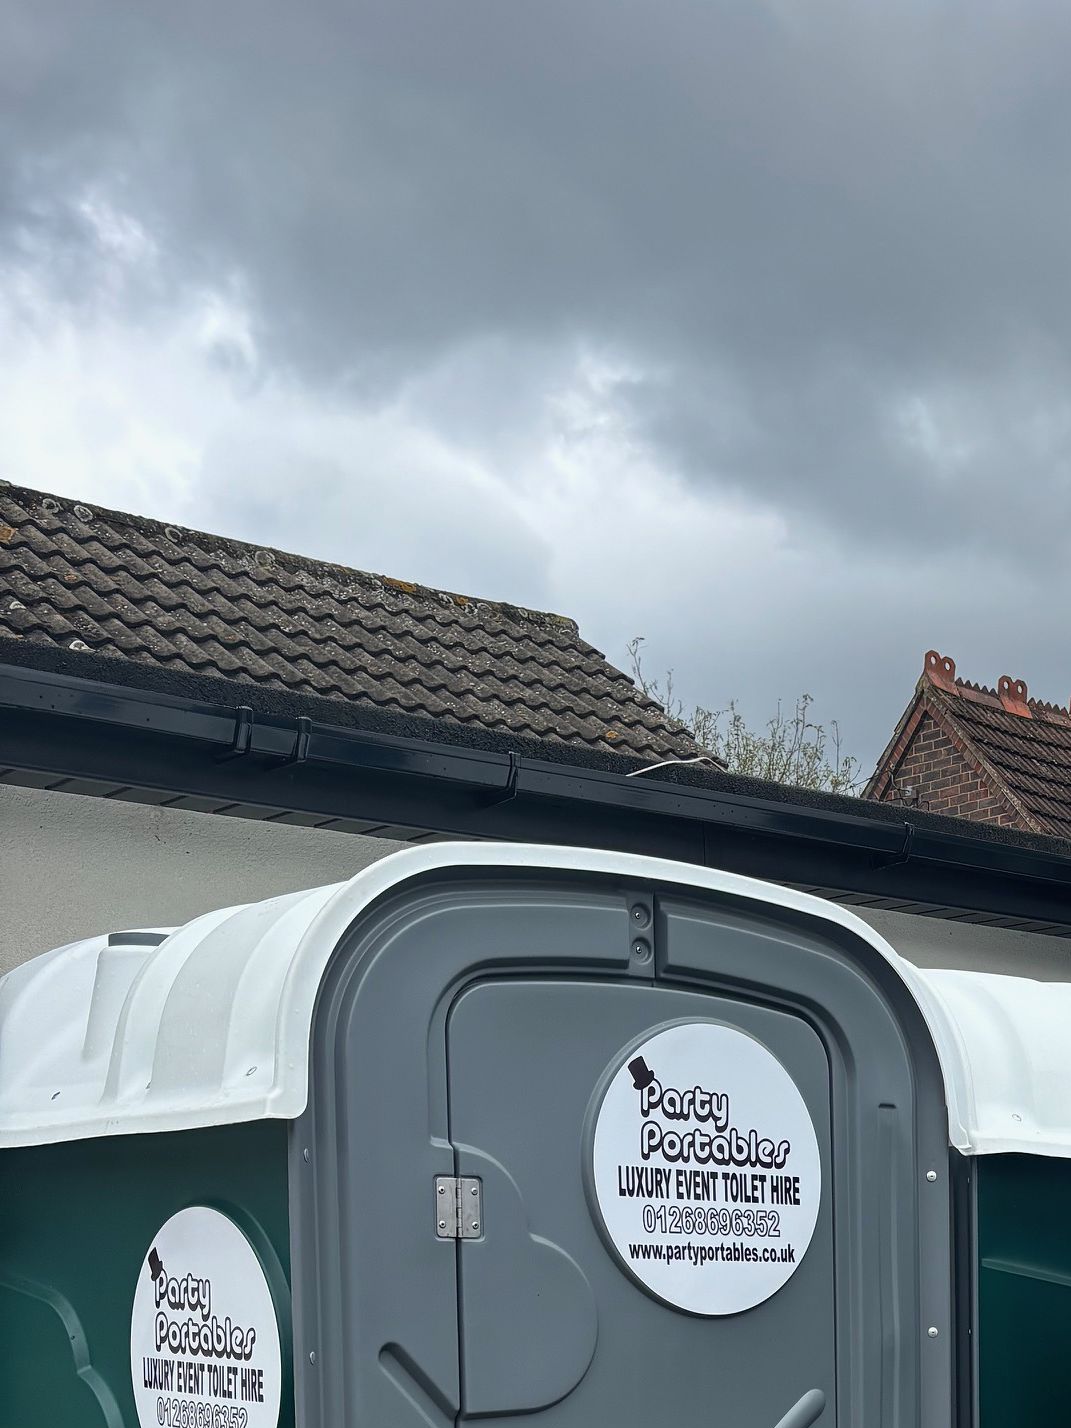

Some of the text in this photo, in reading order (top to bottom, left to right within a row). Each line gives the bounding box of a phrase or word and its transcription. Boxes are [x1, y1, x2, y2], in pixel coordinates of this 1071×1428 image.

[641, 1077, 729, 1132] Party
[641, 1120, 790, 1169] Portables
[618, 1165, 800, 1205] LUXURY EVENT TOILET HIRE
[643, 1204, 780, 1237] 01268696352
[629, 1241, 795, 1266] www.partyportables.co.uk
[154, 1268, 211, 1322] Party
[155, 1311, 256, 1361] Portables
[143, 1357, 264, 1402] LUXURY EVENT TOILET HIRE
